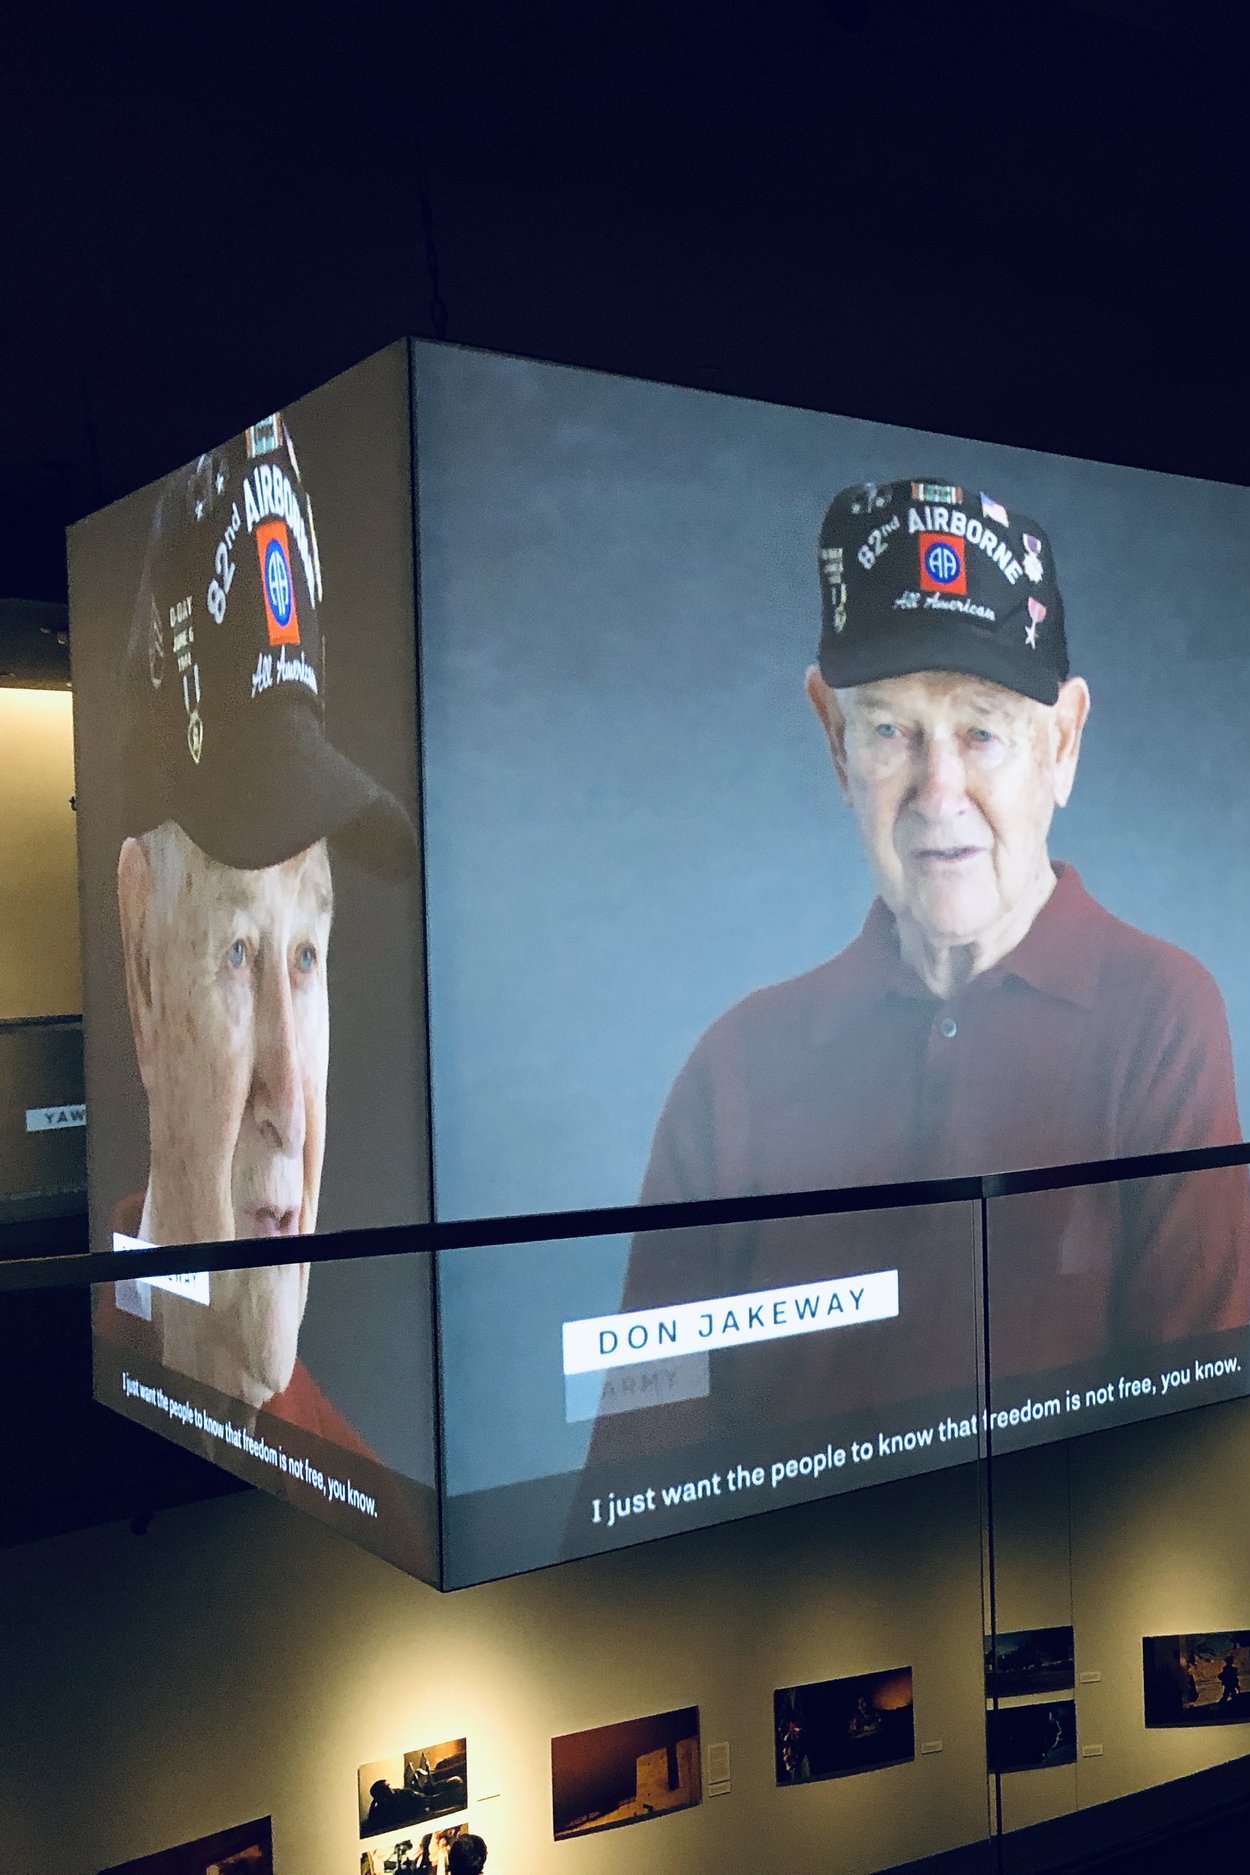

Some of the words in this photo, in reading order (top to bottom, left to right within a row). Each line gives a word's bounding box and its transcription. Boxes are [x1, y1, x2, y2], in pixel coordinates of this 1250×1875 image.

[207, 502, 241, 624] 82nd
[857, 514, 900, 570] 82nd
[908, 505, 1023, 585] AIRBORNE
[928, 547, 957, 579] AA
[893, 590, 921, 611] All
[923, 592, 996, 622] American
[598, 1319, 678, 1355] DON
[697, 1287, 866, 1338] JAKEWAY
[140, 1384, 157, 1406] want
[157, 1388, 169, 1412] the
[169, 1400, 194, 1425] people
[194, 1407, 203, 1429] to
[203, 1409, 225, 1440] know
[225, 1420, 242, 1449] that
[242, 1427, 278, 1466] freedom
[278, 1446, 287, 1472] is
[288, 1457, 304, 1481] not
[304, 1458, 327, 1496] free,
[327, 1476, 346, 1502] you
[347, 1479, 378, 1519] know.
[591, 1498, 602, 1523] I
[606, 1488, 656, 1527] just
[661, 1472, 721, 1506] want
[726, 1465, 766, 1491] the
[771, 1443, 846, 1488] people
[851, 1440, 874, 1465] to
[878, 1426, 934, 1457] know
[938, 1414, 977, 1443] that
[983, 1398, 1061, 1431] freedom
[1066, 1390, 1081, 1412] is
[1085, 1383, 1115, 1407] not
[1118, 1376, 1157, 1400] free,
[1160, 1368, 1191, 1395] you
[1194, 1357, 1242, 1382] know.
